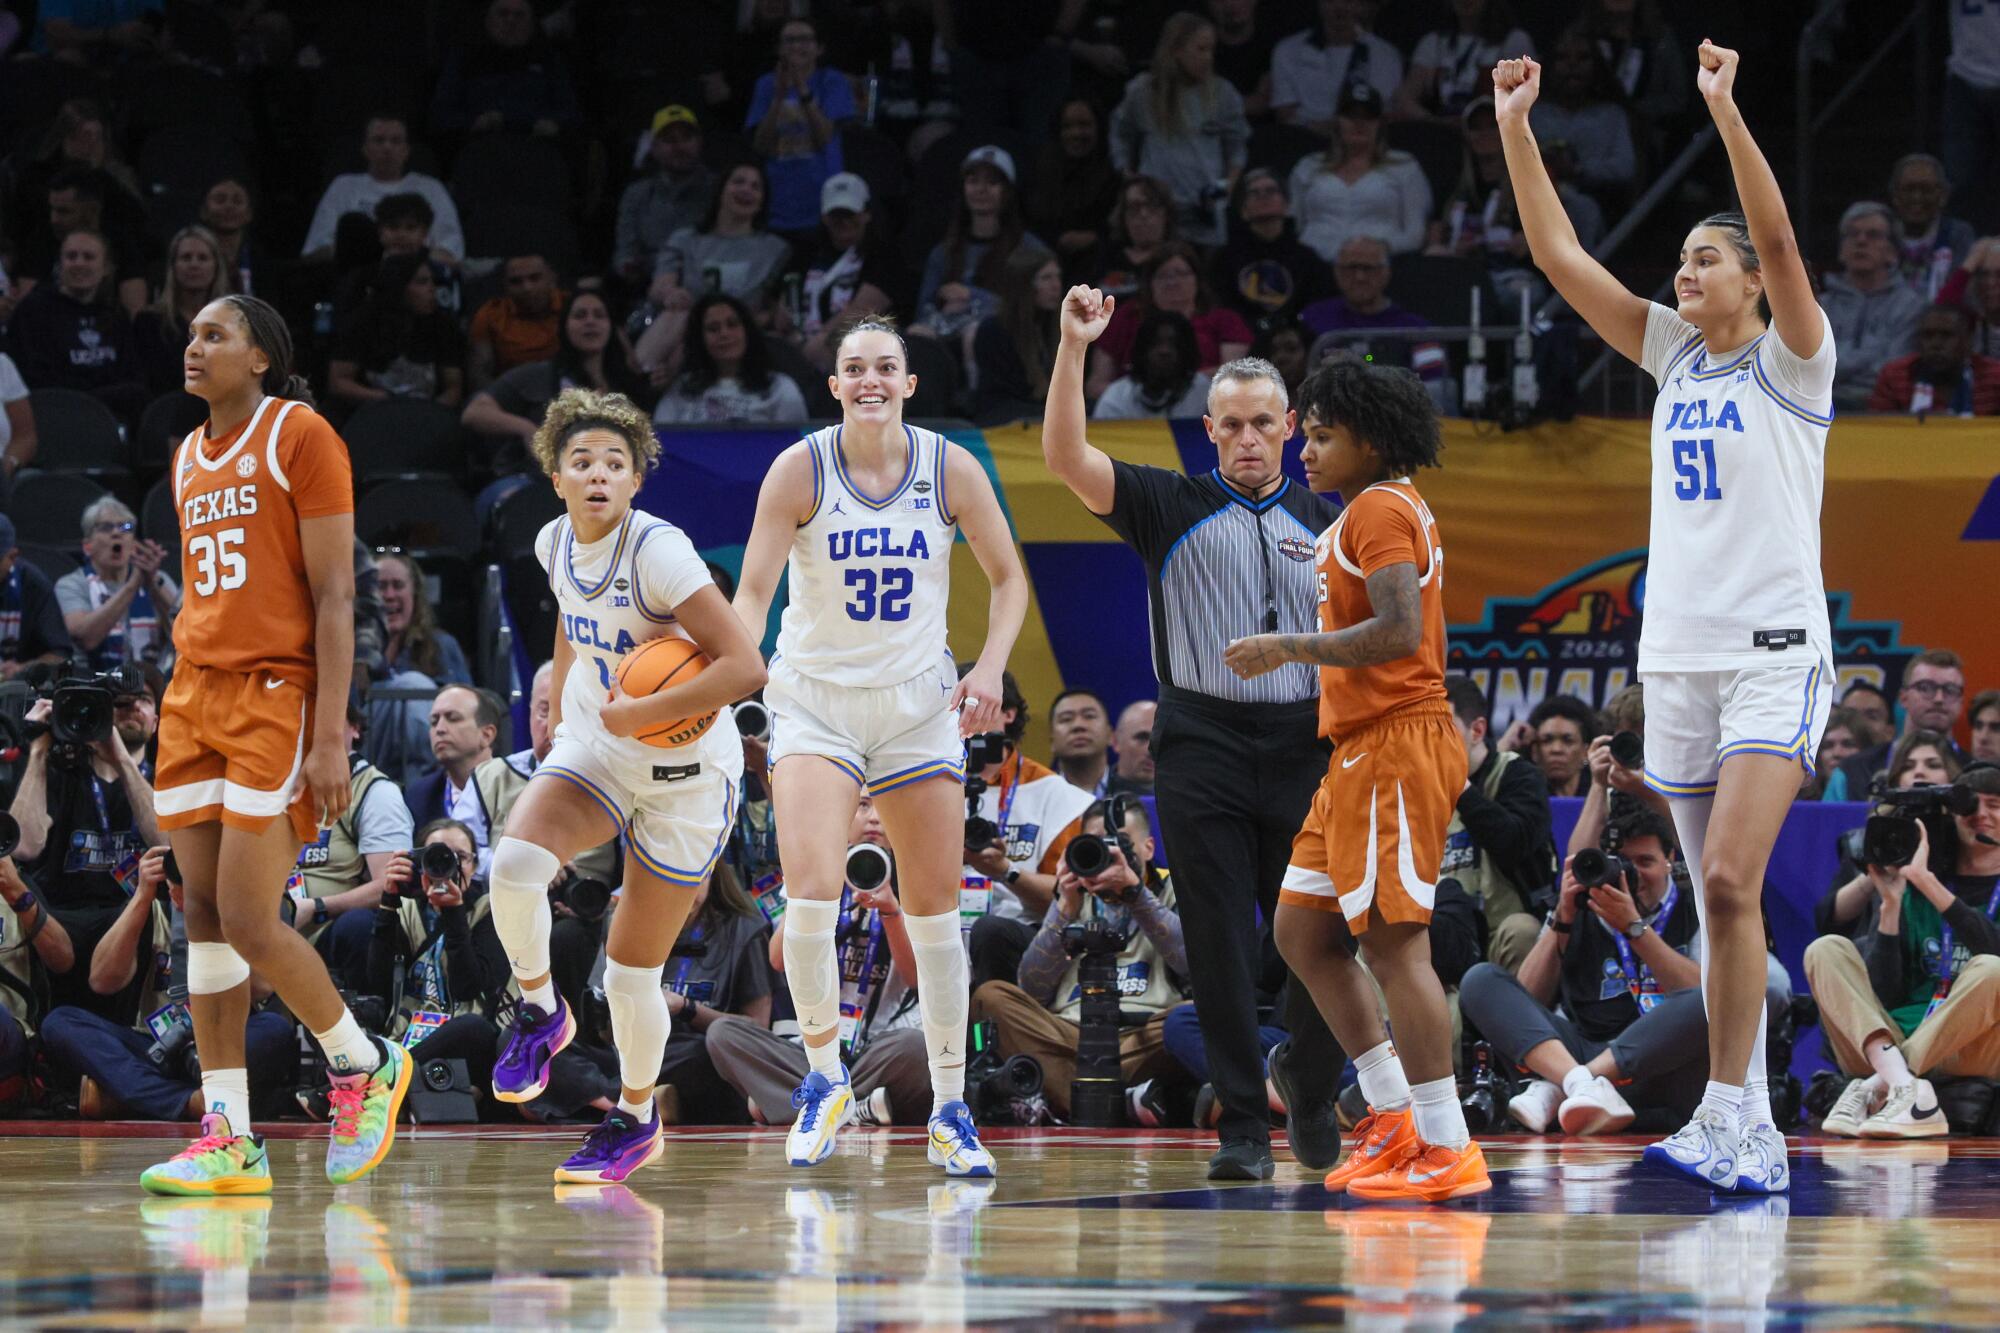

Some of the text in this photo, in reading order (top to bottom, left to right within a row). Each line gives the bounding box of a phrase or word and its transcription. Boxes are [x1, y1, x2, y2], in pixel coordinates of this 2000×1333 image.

[237, 455, 256, 477] SEC
[1672, 439, 1722, 500] 51
[183, 484, 258, 530] TEXAS
[188, 527, 247, 597] 35
[827, 527, 930, 562] UCLA
[1279, 542, 1315, 556] FINAL FOUR
[844, 567, 914, 622] 32
[562, 613, 638, 655] UCLA
[1560, 639, 1625, 659] 2026
